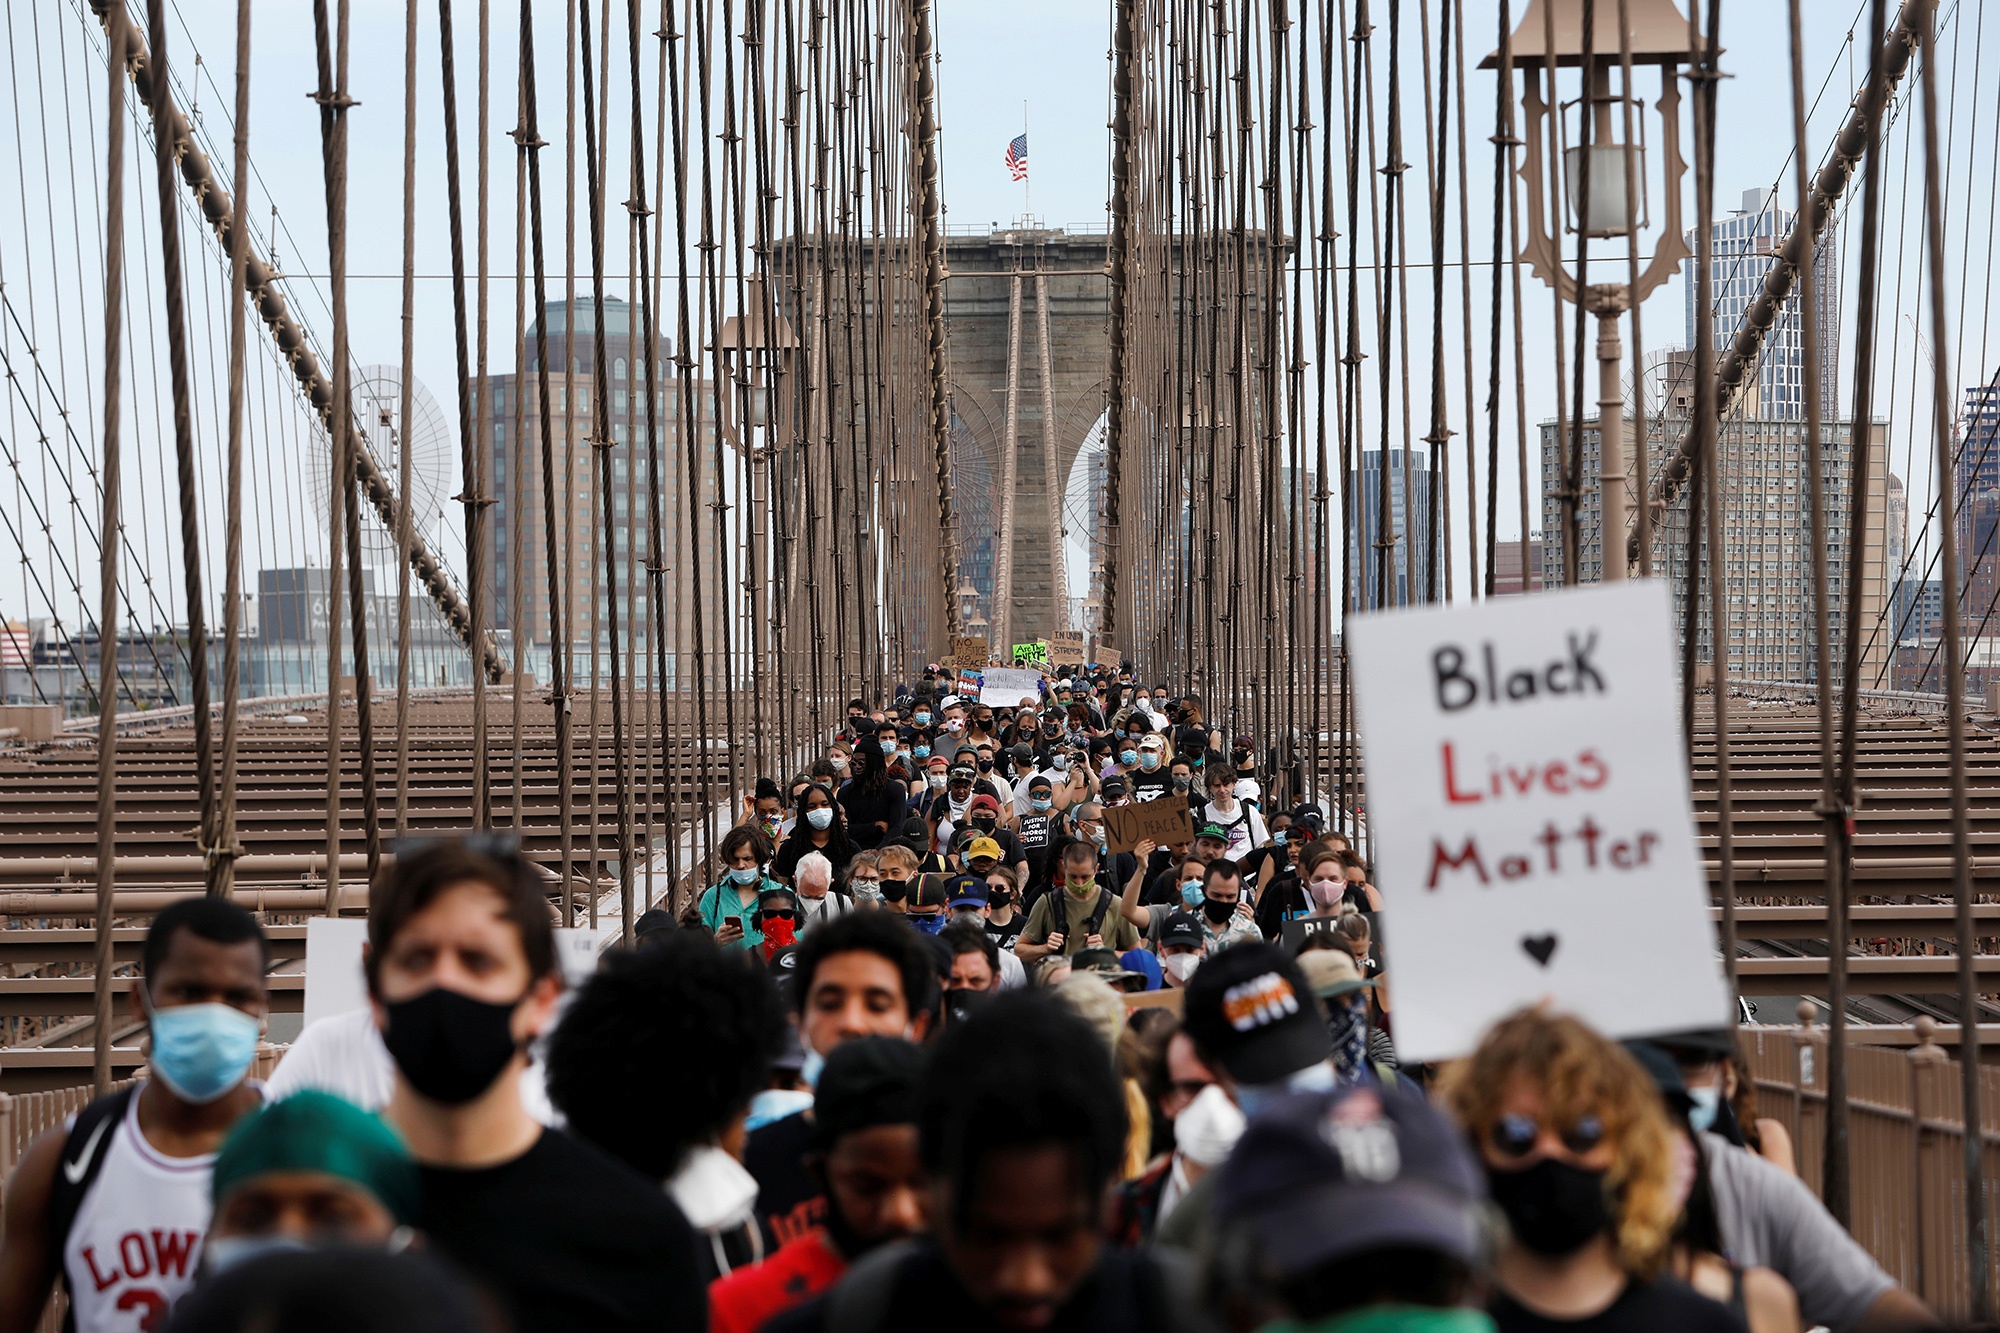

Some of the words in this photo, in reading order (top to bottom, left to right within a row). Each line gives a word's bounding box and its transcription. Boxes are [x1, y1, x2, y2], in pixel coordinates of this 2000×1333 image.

[956, 638, 973, 647] NO
[956, 646, 987, 656] JUSTICE
[957, 659, 987, 669] PEACE
[1441, 740, 1609, 804] Lives
[1143, 796, 1187, 814] JUSTICE
[1023, 816, 1046, 825] JUSTICE
[1103, 808, 1139, 849] NO
[1424, 816, 1660, 890] Matter
[82, 1229, 199, 1293] LOW
